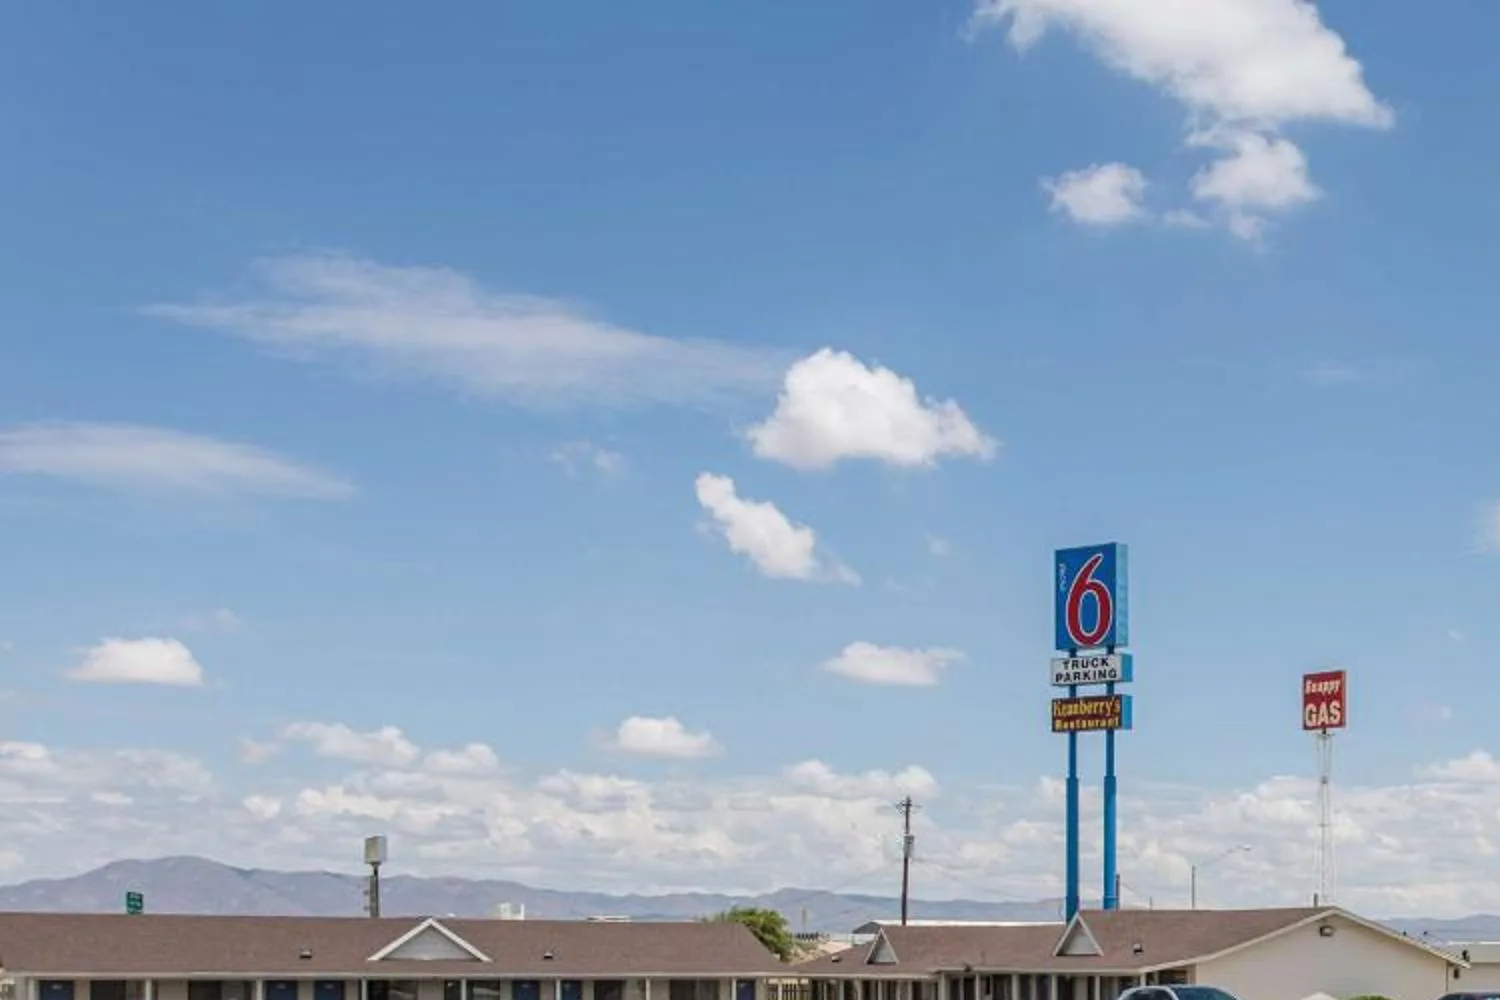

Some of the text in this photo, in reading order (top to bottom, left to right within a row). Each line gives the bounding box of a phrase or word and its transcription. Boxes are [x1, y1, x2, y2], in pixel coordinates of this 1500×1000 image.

[1065, 553, 1113, 647] 6
[1062, 657, 1109, 670] TRUCK
[1055, 668, 1117, 682] PARKING
[1305, 700, 1341, 727] GAS
